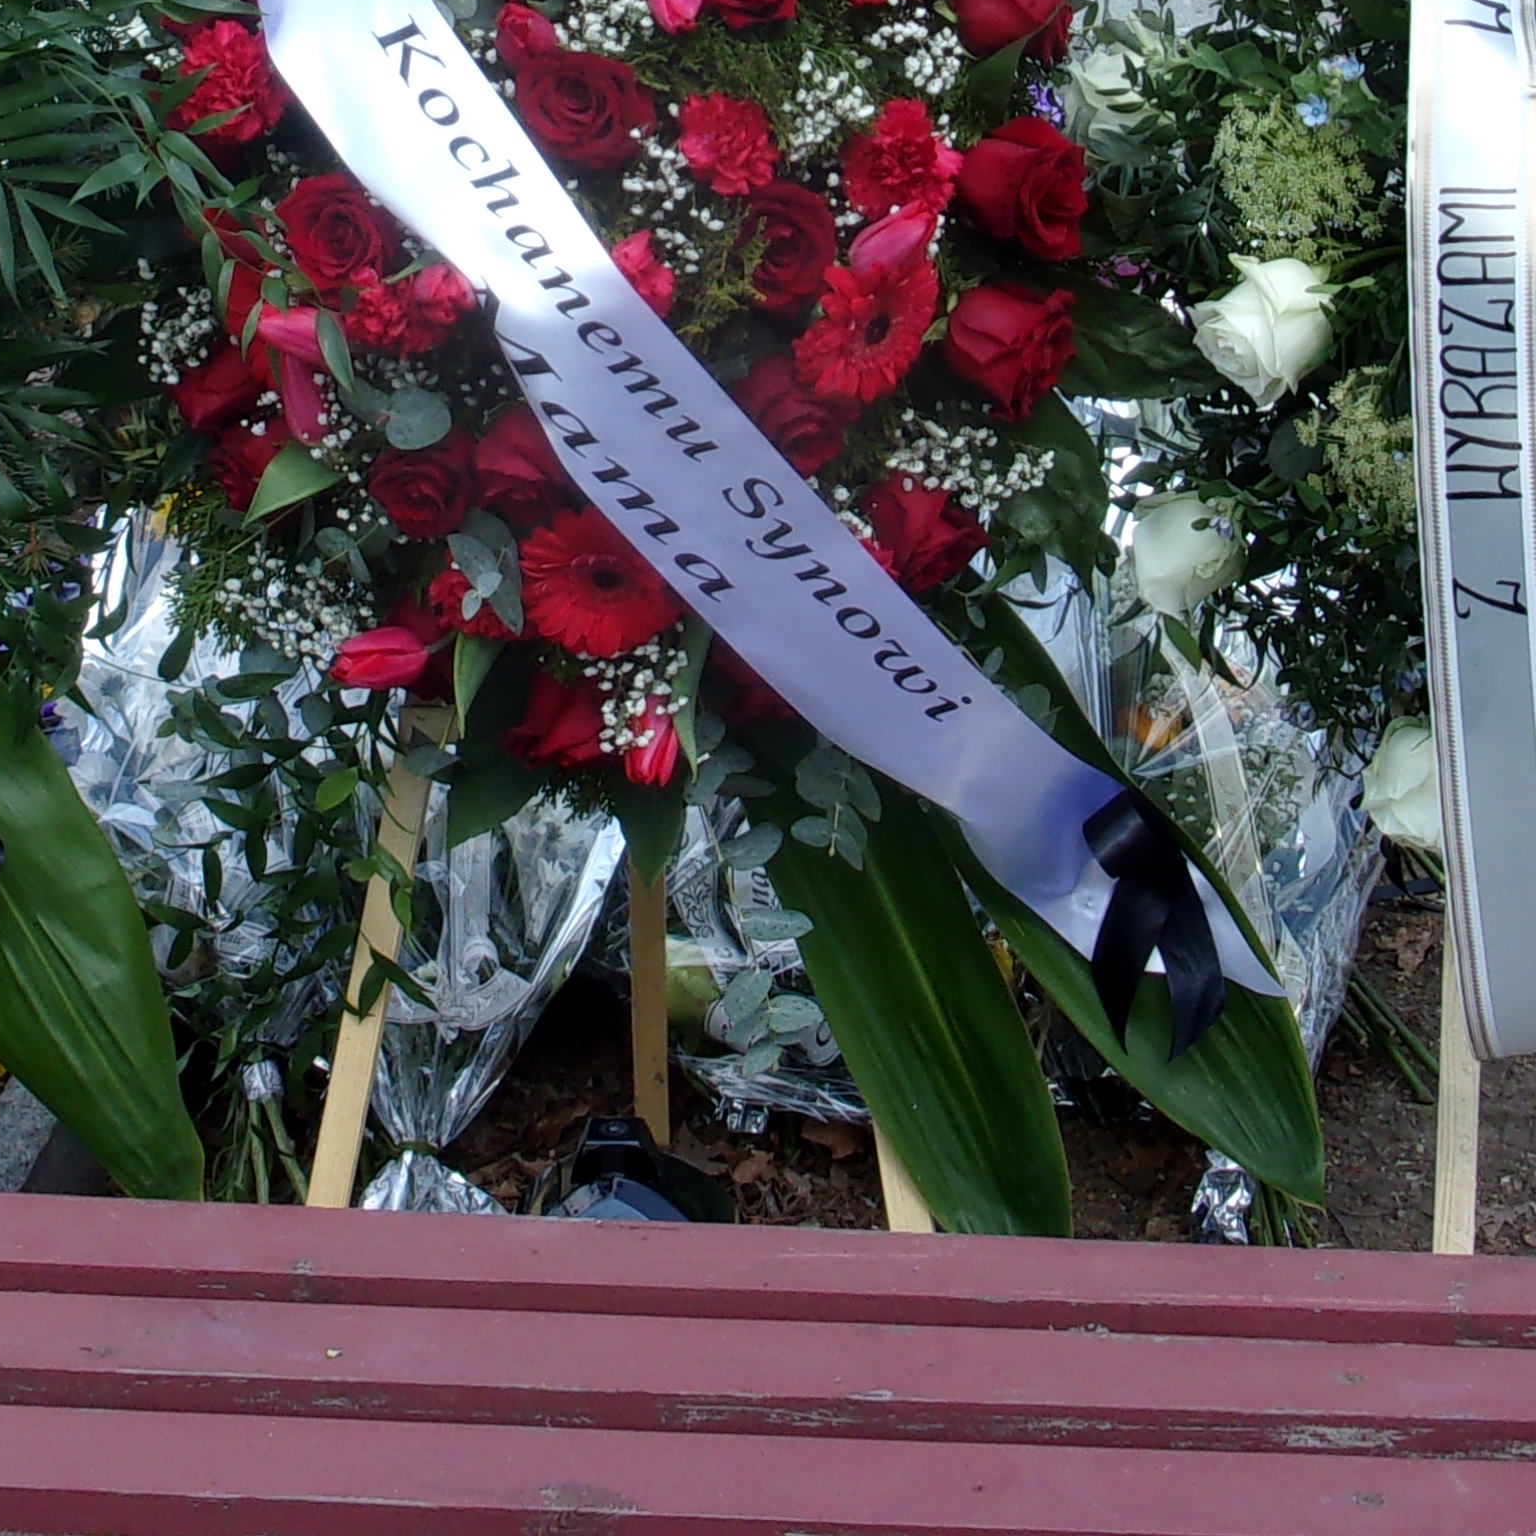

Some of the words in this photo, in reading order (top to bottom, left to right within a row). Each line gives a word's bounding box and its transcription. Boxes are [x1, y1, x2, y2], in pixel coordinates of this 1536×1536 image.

[370, 14, 721, 464] Kochanemu
[721, 474, 974, 725] Synowi
[476, 275, 735, 604] Mama
[1437, 187, 1522, 500] WYRAZAMI
[1452, 576, 1527, 620] Z
